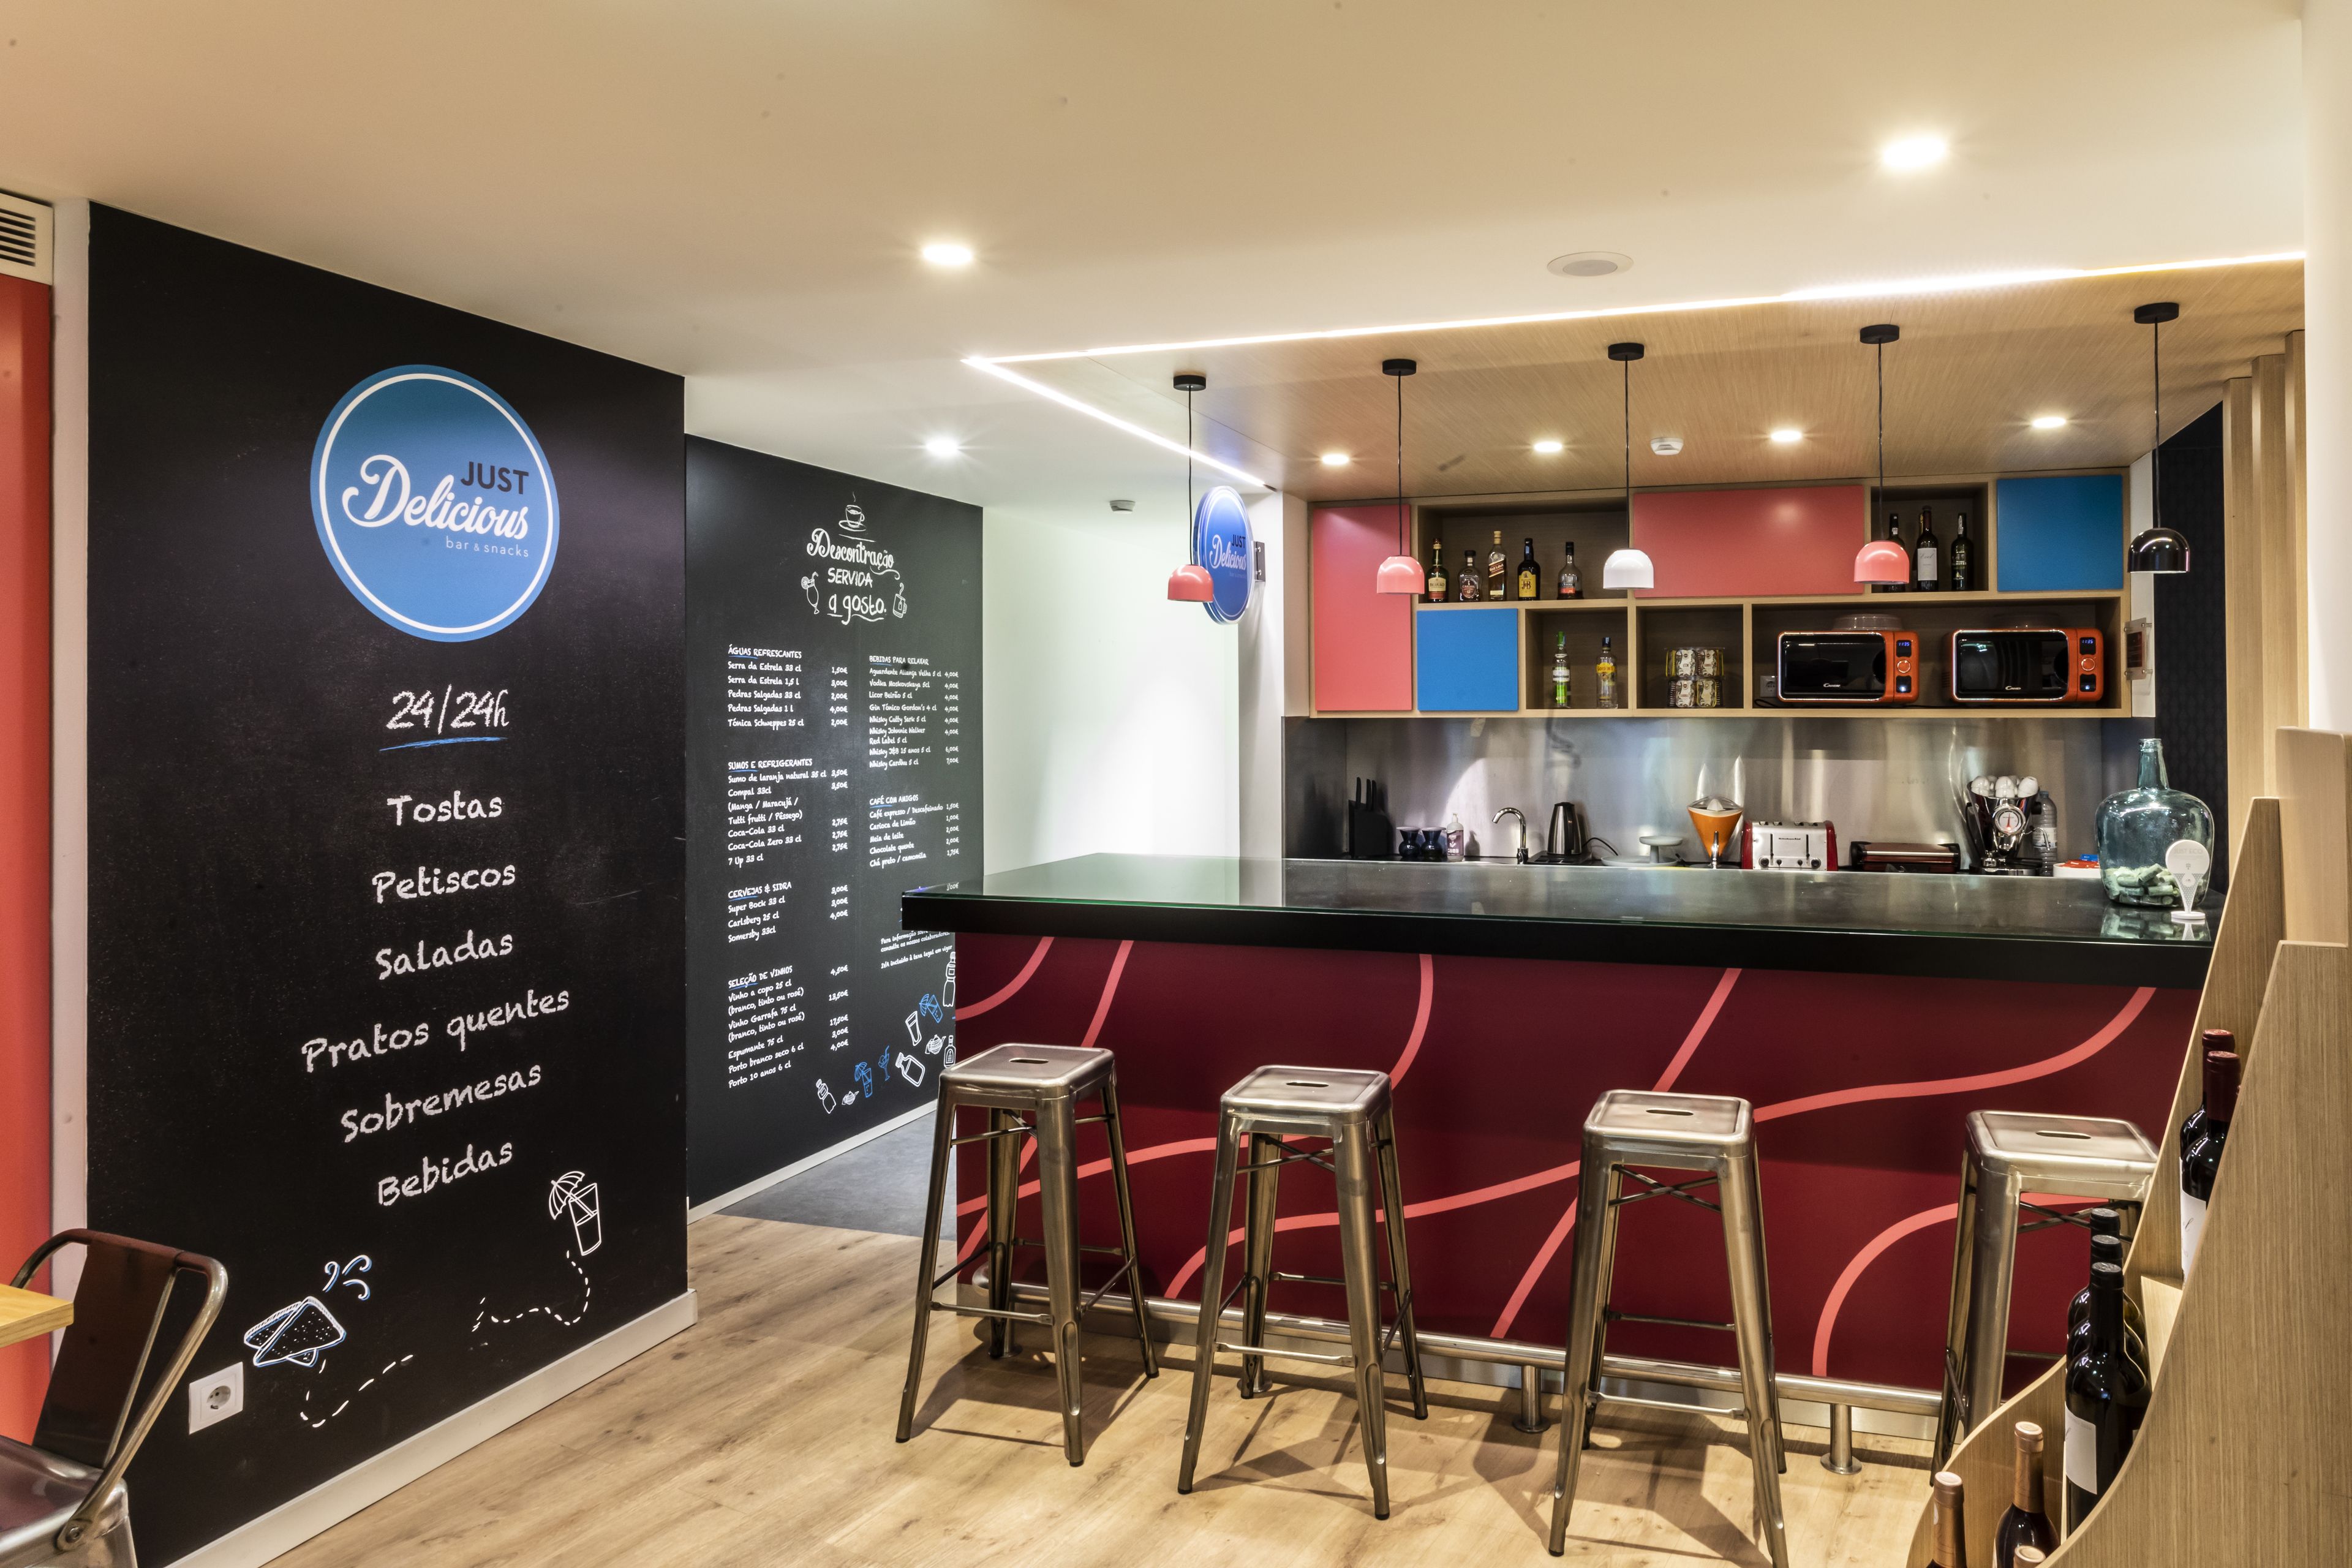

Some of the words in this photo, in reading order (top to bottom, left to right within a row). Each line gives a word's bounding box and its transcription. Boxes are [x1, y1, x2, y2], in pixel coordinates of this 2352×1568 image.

[461, 461, 529, 495] JUST
[342, 454, 529, 540] Delicious
[446, 536, 469, 550] bar
[473, 543, 480, 552] &
[484, 543, 529, 558] snacks
[807, 527, 895, 570] Descontração
[1231, 534, 1246, 548] JUST
[1209, 534, 1247, 570] Delicious
[827, 567, 873, 588] SERVIDA
[829, 595, 838, 614] a
[842, 593, 887, 625] gosto.
[728, 644, 751, 655] ÁGUAS
[753, 649, 802, 658] REFRESCANTES
[728, 689, 752, 698] Pedras
[753, 690, 782, 701] Salgadas
[386, 684, 509, 736] 24/24h
[728, 718, 752, 726] Tónica
[754, 718, 786, 730] Schweppes
[728, 761, 748, 770] SUMOS
[758, 758, 812, 768] REFRIGERANTES
[760, 772, 784, 783] laranja
[831, 769, 848, 778] 3,50€
[728, 788, 755, 800] Compal
[757, 786, 772, 794] 33cl
[831, 782, 848, 791] 3,50€
[386, 790, 502, 827] Tostas
[728, 802, 753, 812] (Manga
[755, 801, 760, 809] /
[763, 797, 792, 809] Maracujá
[728, 816, 745, 824] Tutti
[748, 813, 766, 824] frutti
[768, 813, 773, 821] /
[775, 809, 802, 821] Pêssego)
[832, 830, 848, 840] 2,75€
[728, 840, 765, 851] Coca-Cola
[832, 843, 848, 852] 2,75€
[735, 856, 744, 868] Up
[372, 864, 516, 905] Petiscos
[728, 886, 763, 899] CERVEJAS
[772, 881, 792, 892] SIDRA
[831, 884, 848, 895] 3,00€
[728, 904, 747, 916] Super
[749, 900, 766, 909] Bock
[831, 897, 848, 908] 3,00€
[728, 916, 761, 928] Carlsberg
[830, 910, 848, 920] 4,00€
[728, 929, 760, 943] Somersby
[761, 925, 776, 935] 33cl
[375, 929, 513, 981] Saladas
[728, 973, 757, 988] SELEÇÃO
[759, 971, 768, 980] DE
[770, 965, 793, 978] VINHOS
[831, 965, 848, 976] 4,50€
[728, 992, 748, 1002] Vinho
[758, 986, 774, 997] copo
[728, 1003, 756, 1016] (branco,
[758, 997, 774, 1006] tinto
[787, 987, 804, 998] rosé)
[829, 990, 848, 1001] 13,50€
[728, 1019, 748, 1030] Vinho
[750, 1008, 778, 1023] Garrafa
[830, 1014, 848, 1026] 17,50€
[301, 1022, 429, 1074] Pratos
[447, 989, 570, 1052] quentes
[832, 1027, 848, 1038] 3,00€
[728, 1042, 765, 1061] Espumante
[767, 1038, 775, 1047] 75
[728, 1062, 747, 1074] Porto
[750, 1055, 773, 1067] branco
[775, 1049, 790, 1058] seco
[340, 1063, 542, 1144] Sobremesas
[378, 1142, 513, 1207] Bebidas
